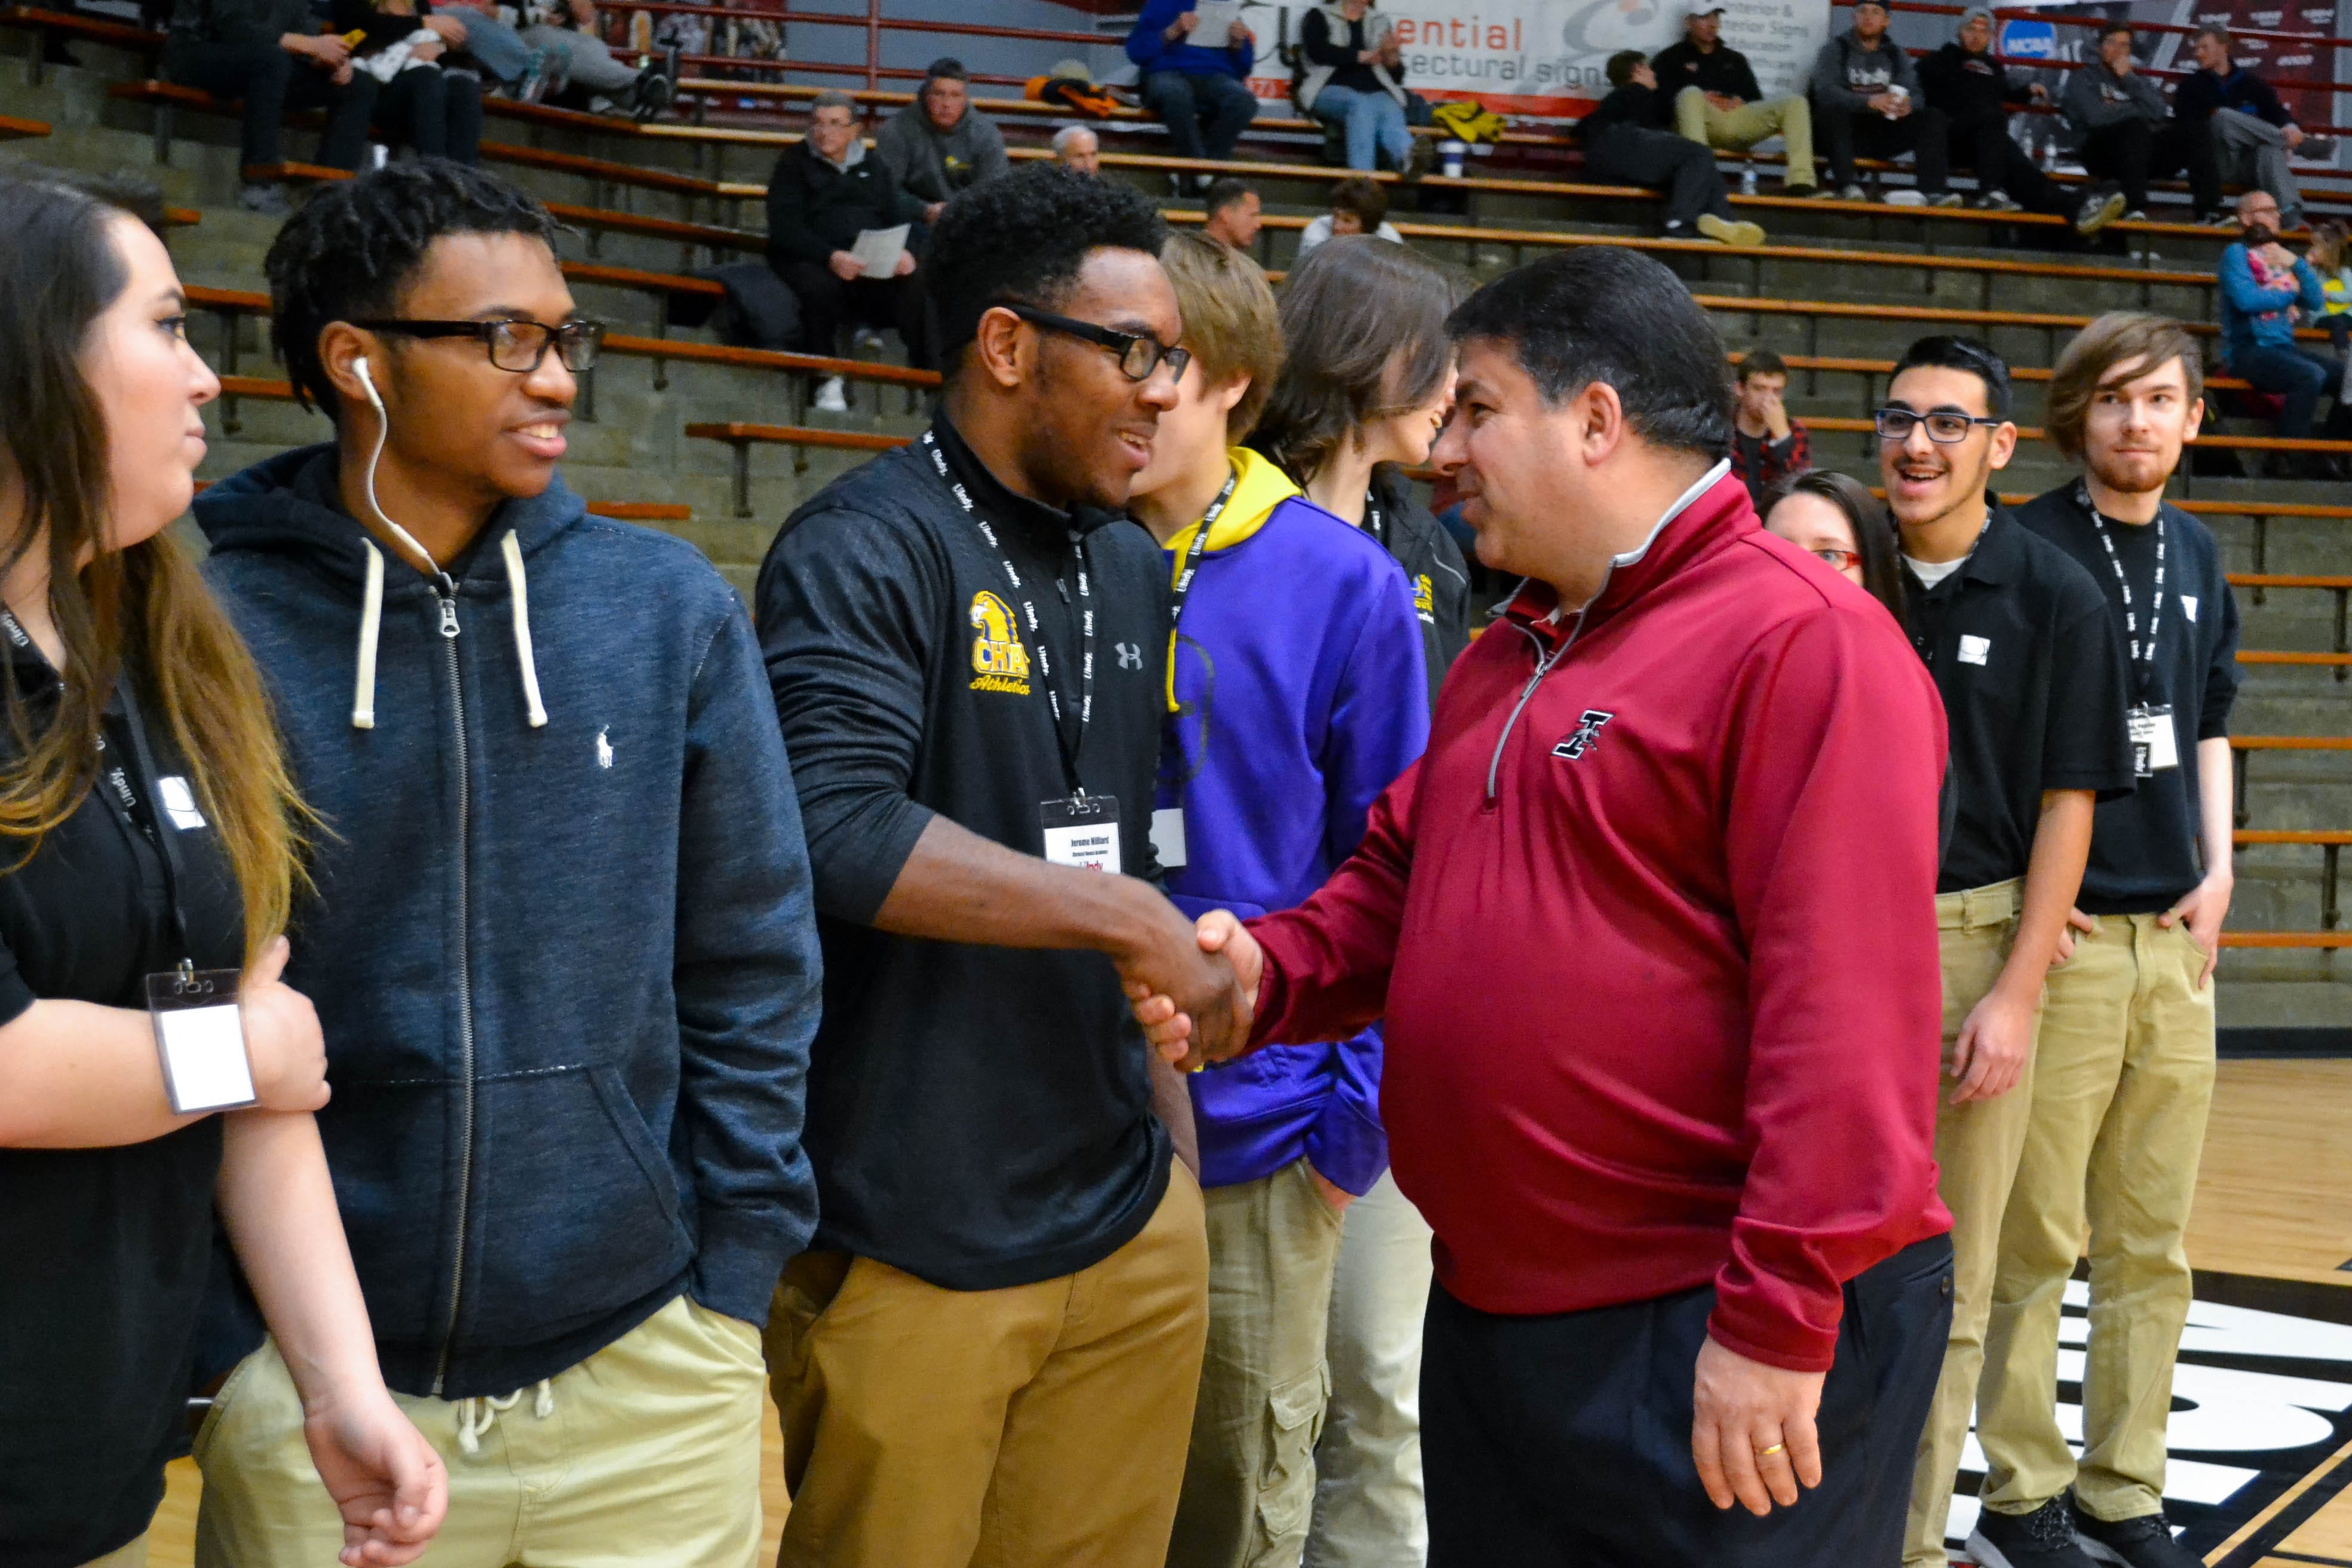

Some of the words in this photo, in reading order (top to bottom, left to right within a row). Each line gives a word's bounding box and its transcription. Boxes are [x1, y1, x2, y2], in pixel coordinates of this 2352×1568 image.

[1396, 15, 1522, 51] ential
[1400, 54, 1526, 81] ectural
[974, 638, 1029, 677] CHA
[969, 674, 1031, 695] Athletics
